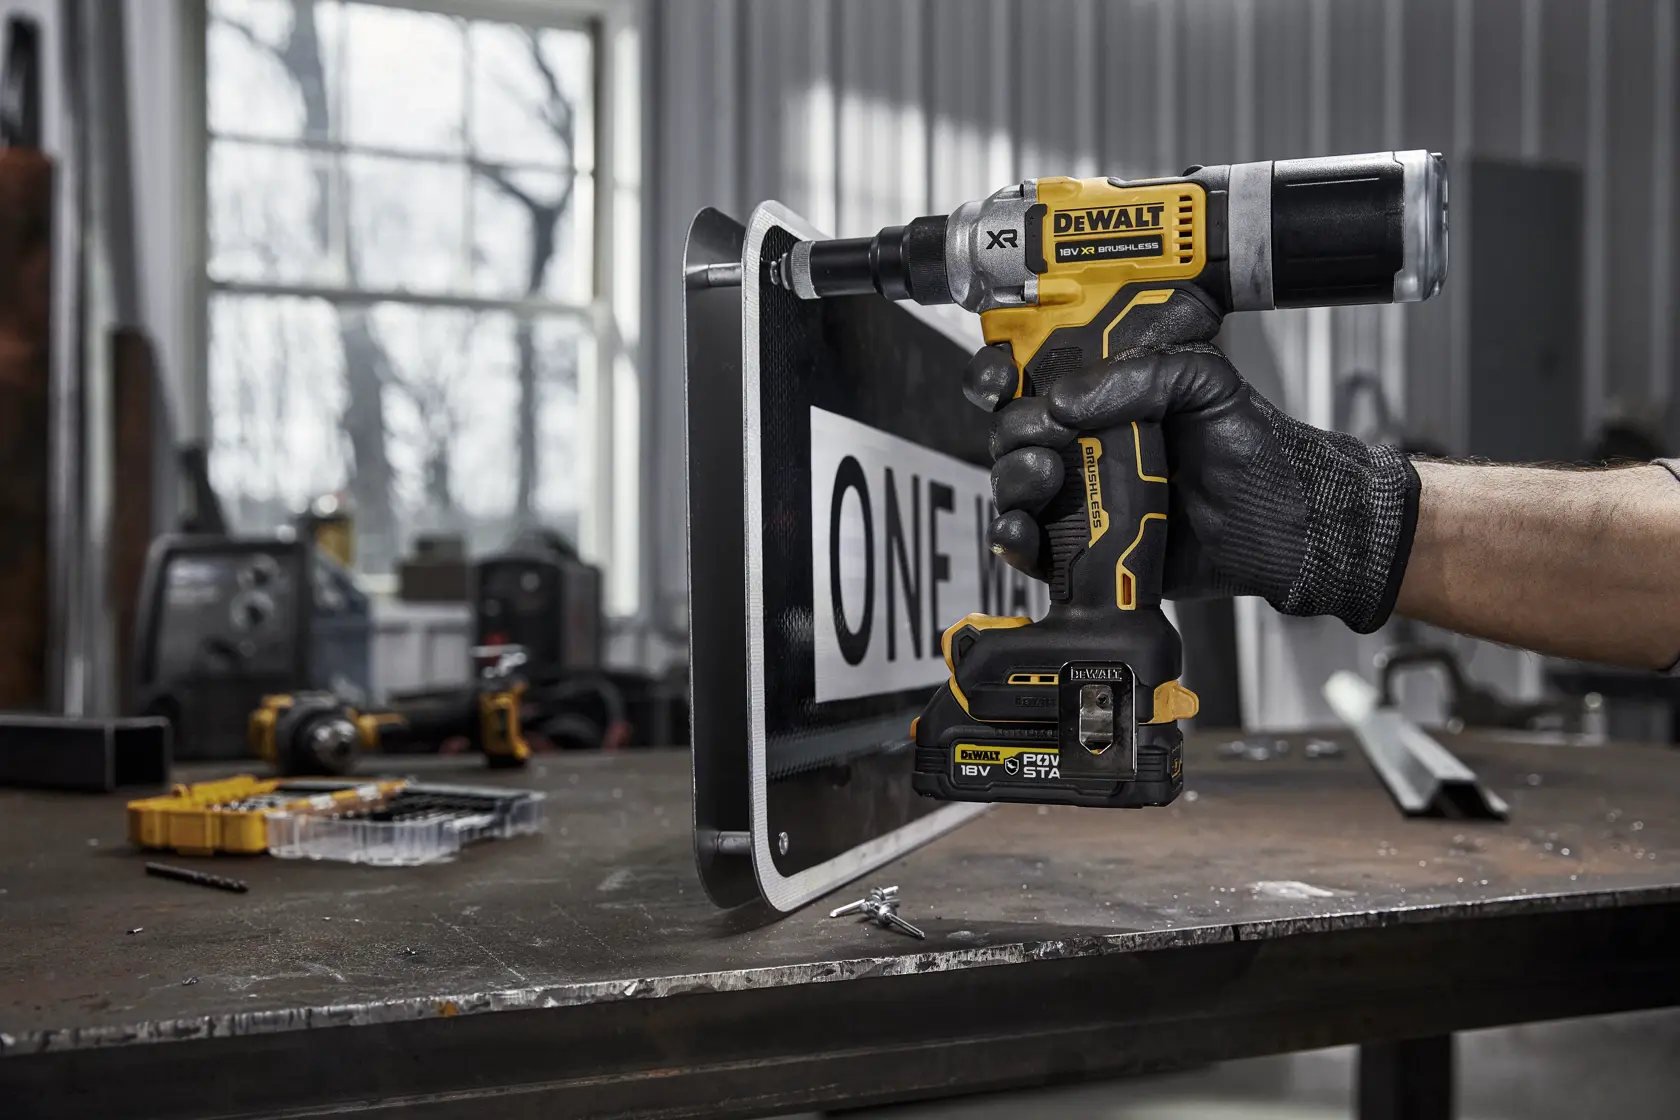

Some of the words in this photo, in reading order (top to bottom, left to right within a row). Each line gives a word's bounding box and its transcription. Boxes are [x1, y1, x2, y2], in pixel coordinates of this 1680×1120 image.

[1053, 206, 1164, 234] DEWALT
[986, 228, 1019, 250] XR
[1059, 246, 1079, 257] 18V
[1080, 245, 1095, 256] XR
[1098, 241, 1160, 254] BRUSHLESS
[1085, 446, 1102, 529] BRUSHLESS
[829, 454, 956, 666] ONE
[961, 765, 991, 777] 18V
[1023, 766, 1060, 779] STA
